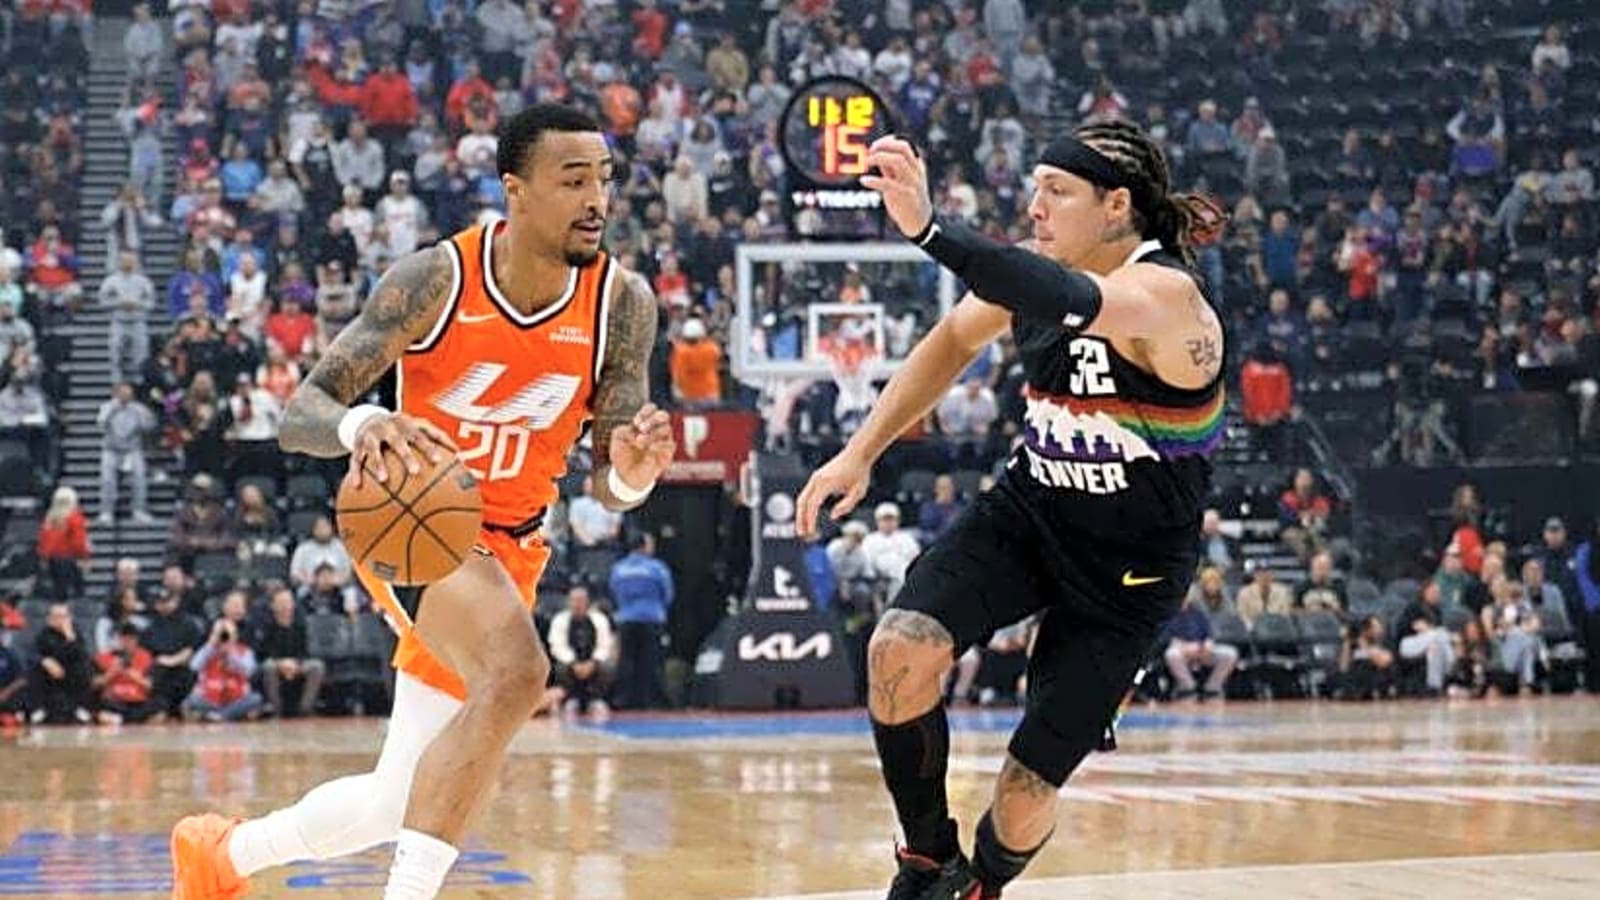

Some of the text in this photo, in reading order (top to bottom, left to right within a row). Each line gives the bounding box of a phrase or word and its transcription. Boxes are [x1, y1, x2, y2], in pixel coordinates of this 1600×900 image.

[824, 125, 866, 174] 15
[1069, 337, 1117, 394] 32
[431, 361, 582, 431] LA
[456, 421, 530, 480] 20
[739, 632, 832, 660] KIA
